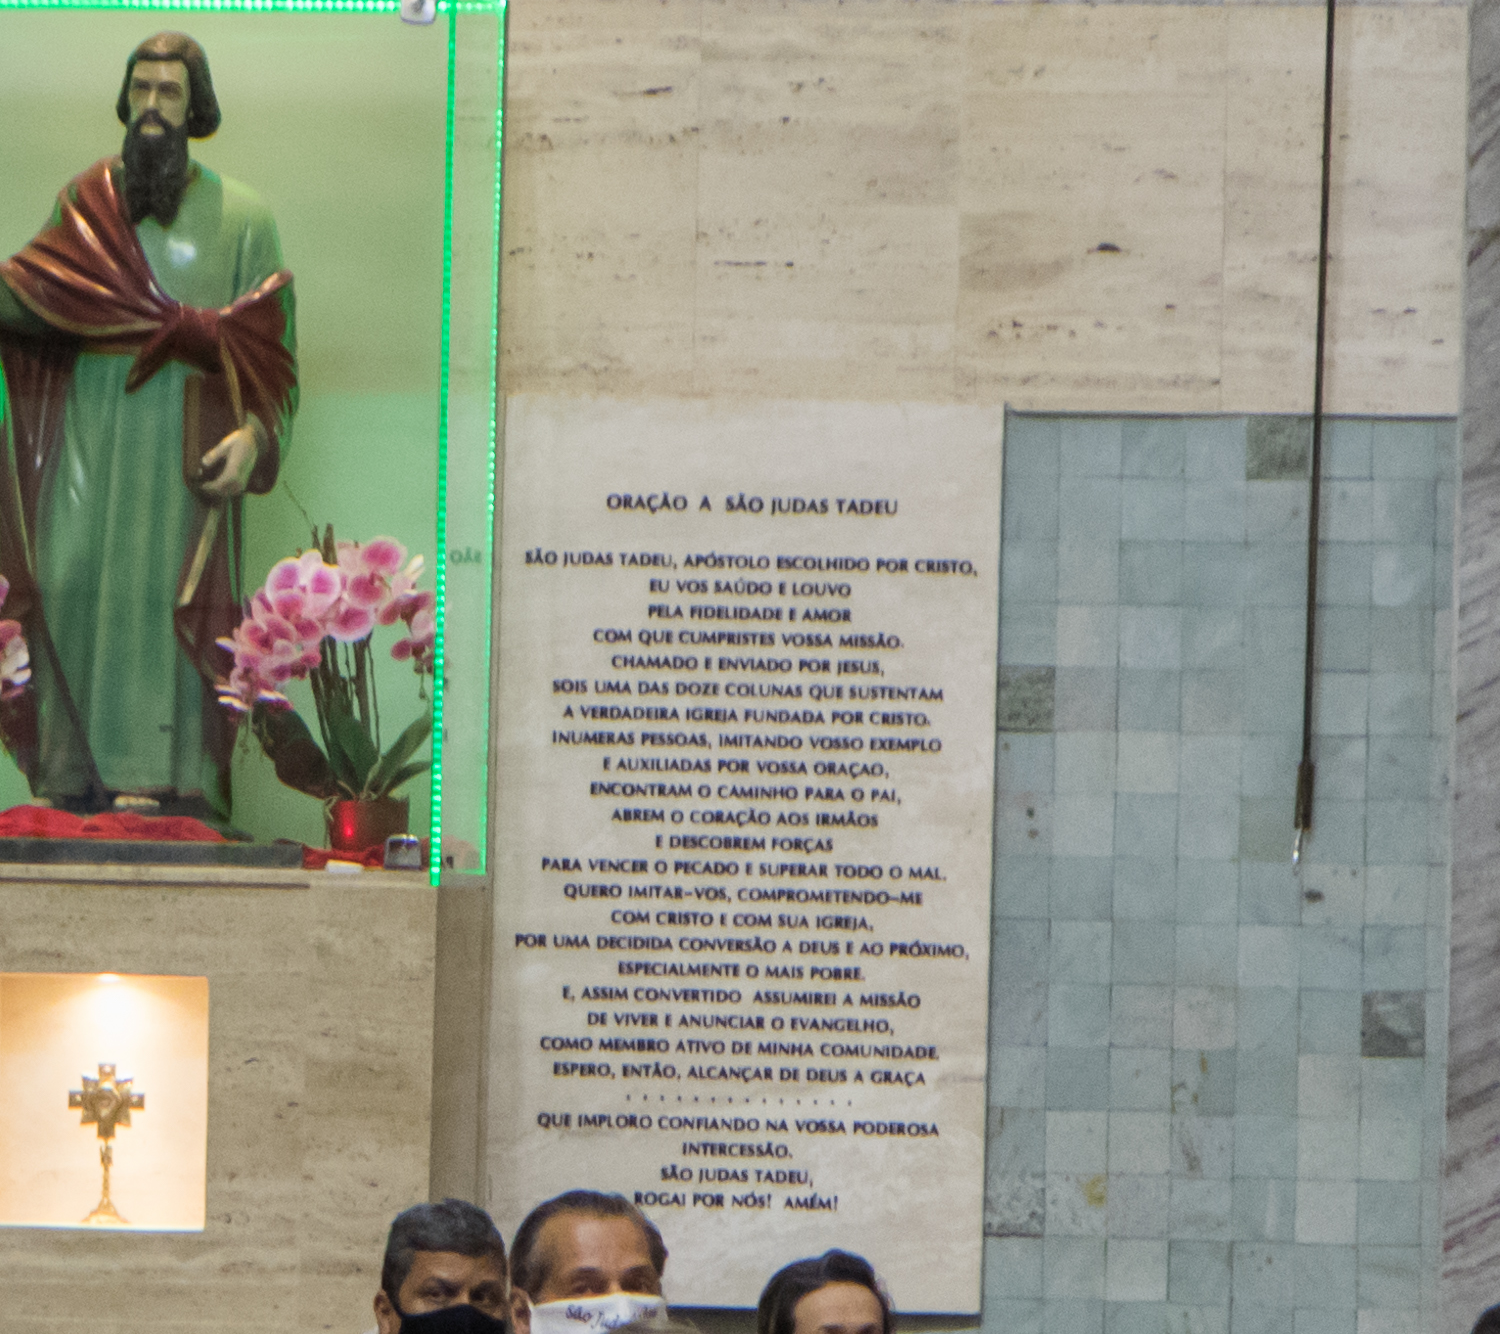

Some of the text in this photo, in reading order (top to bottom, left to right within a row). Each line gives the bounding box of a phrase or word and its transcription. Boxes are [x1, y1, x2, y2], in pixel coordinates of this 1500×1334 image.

[605, 490, 689, 516] ORAÇÃO
[724, 492, 765, 514] SÃO
[770, 497, 830, 518] JUDAS
[835, 497, 899, 518] TADEU
[524, 547, 978, 578] SÃO JUDAS TADEU, APÓSTOLO ESCOLHIDO POR CRISTO,
[649, 576, 852, 599] EU VOS SAÚDO E LOUVO
[647, 604, 852, 624] PELA FIDELIDADE E AMOR
[592, 627, 904, 651] COM QUE CUMPRISTES VOSSA MISSÃO.
[610, 654, 885, 677] CHAMADO E ENVIADO POR JESUS,
[552, 677, 944, 703] SOIS UMA DAS DOZE COLUNAS QUE SUSTENTAM
[562, 704, 931, 728] A VERDADEIRA IGREJA FUNDADA POR CRISTO.
[589, 780, 902, 805] ENCONTRAM O CAMINHO PARA O PAI,
[610, 806, 879, 829] ABREM O CORAÇÃO AOS IRMÃOS
[655, 834, 834, 855] E DESCOBREM FORÇAS
[541, 856, 947, 882] PARA VENCER O PECADO E SUPERAR TODO O MAL.
[563, 883, 923, 907] QUERO IMITAR-VOS, COMPROMETENDO-ME
[610, 909, 874, 932] COM CRISTO E COM SUA IGREJA,
[514, 932, 969, 959] POR UMA DECIDIDA CONVERSÃO A DEUS E AO PRÓXIMO,
[617, 960, 740, 979] ESPECIALMENTE
[745, 964, 760, 979] O
[765, 964, 804, 980] MAIS
[587, 1011, 895, 1035] DE VIVER E ANUNCIAR O EVANGELHO,
[539, 1035, 594, 1053] COMO
[598, 1036, 670, 1054] MEMBRO
[675, 1038, 726, 1055] ATIVO
[731, 1040, 753, 1056] DE
[757, 1041, 814, 1059] MINHA
[552, 1060, 926, 1088] ESPERO, ENTÃO, ALCANÇAR DE DEUS A GRAÇA
[536, 1111, 940, 1139] QUE IMPLORO CONFIANDO NA VOSSA PODEROSA
[681, 1139, 793, 1159] INTERCESSÃO.
[660, 1163, 814, 1187] SÃO JUDAS TADEU,
[632, 1190, 839, 1212] ROGAI POR NÓS! AMÉM!
